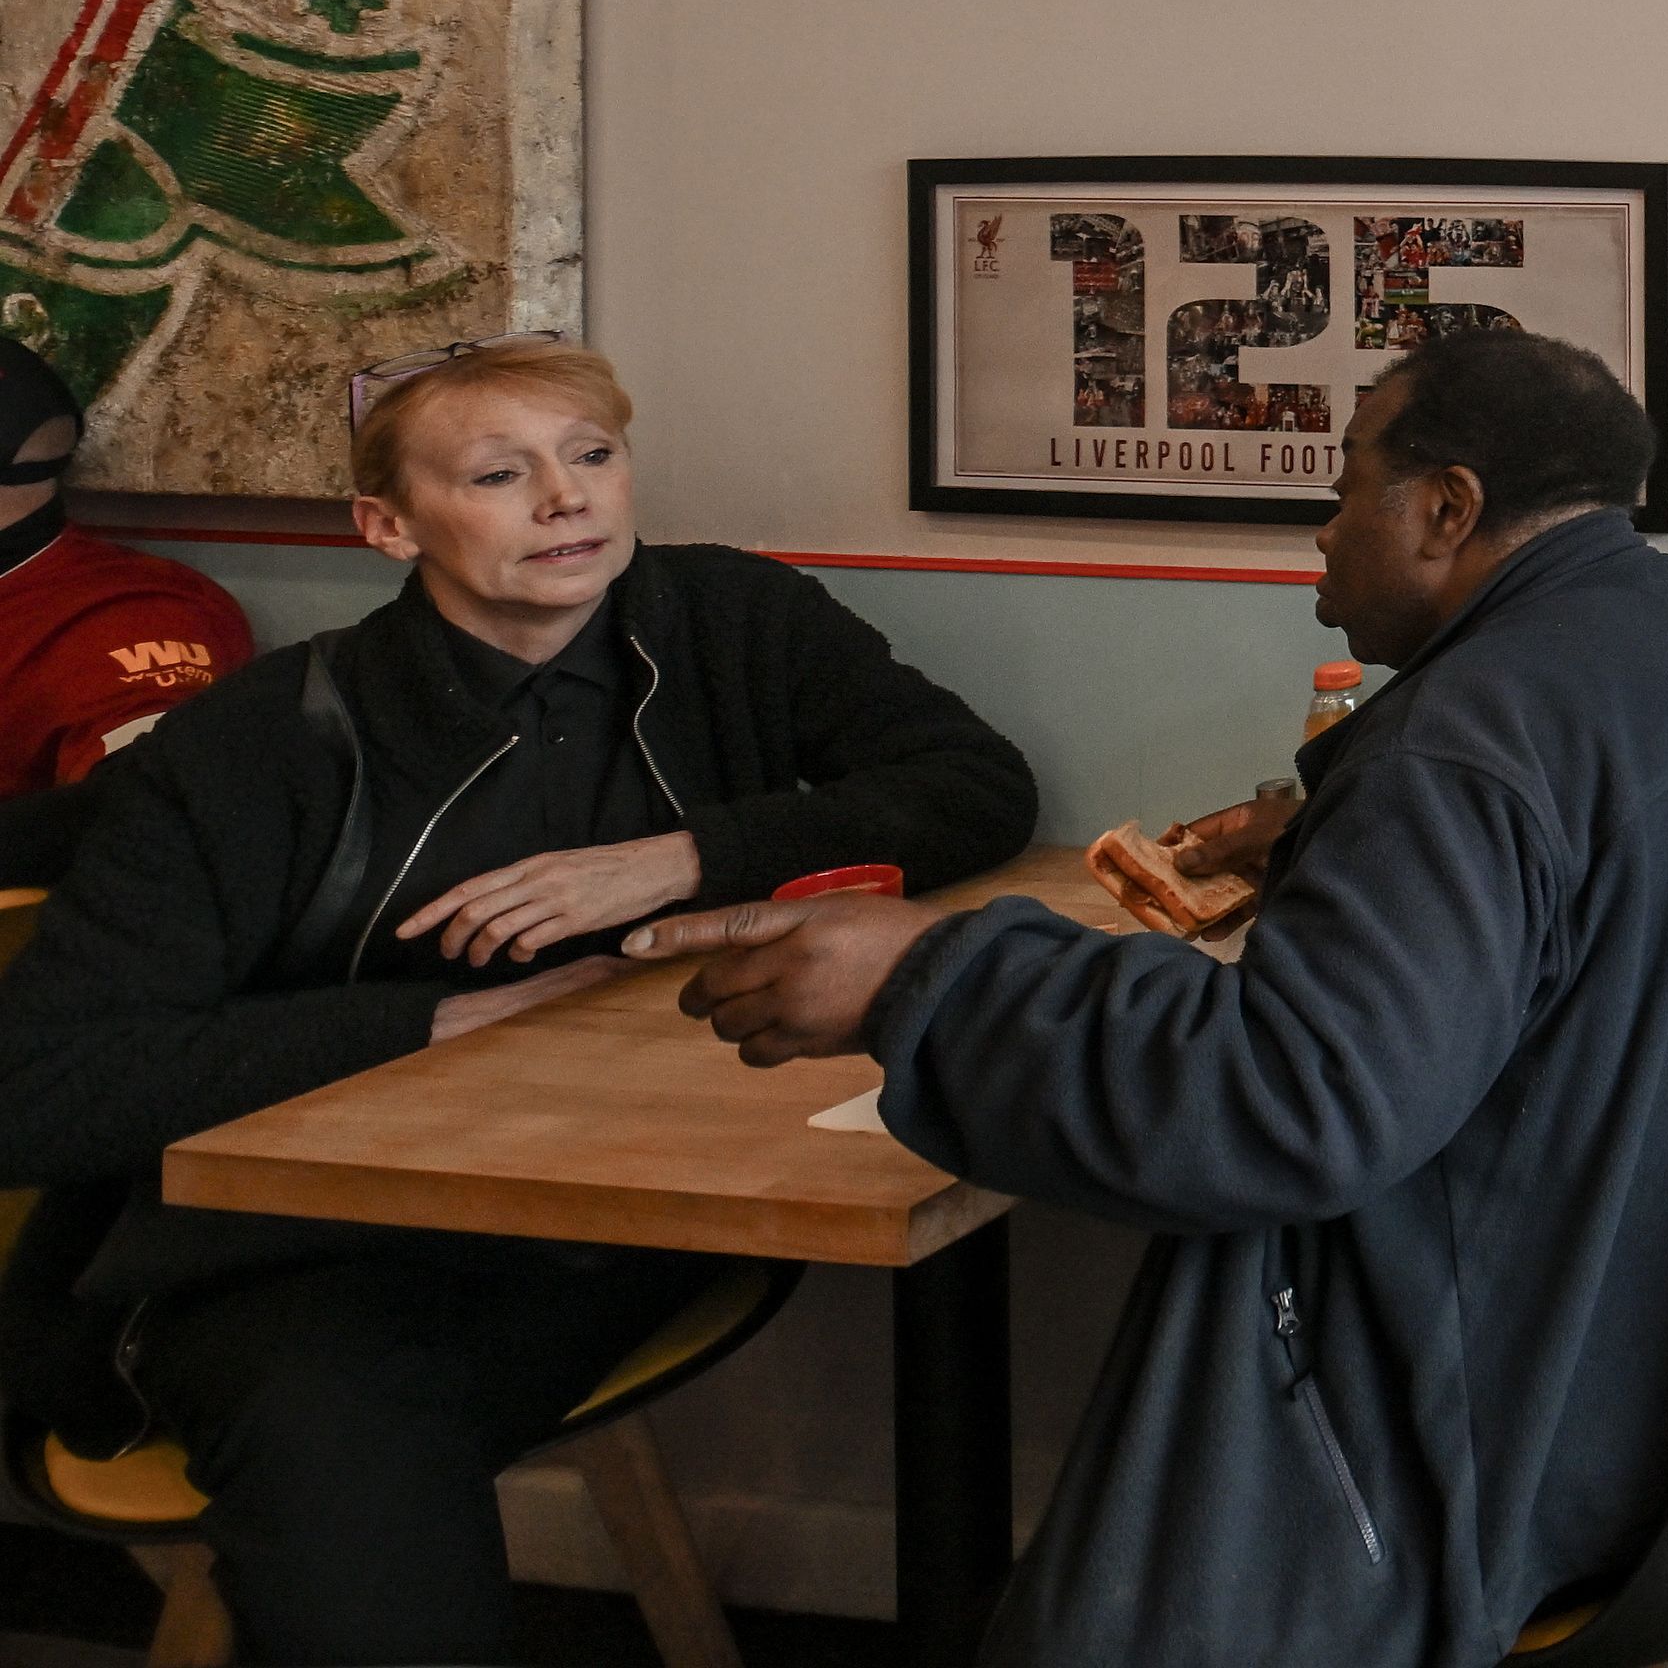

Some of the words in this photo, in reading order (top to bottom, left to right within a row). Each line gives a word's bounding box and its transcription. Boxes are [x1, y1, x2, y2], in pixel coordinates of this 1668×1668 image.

[1050, 437, 1235, 473] LIVERPOOL
[1260, 443, 1344, 475] FOOT
[108, 640, 211, 673] WU
